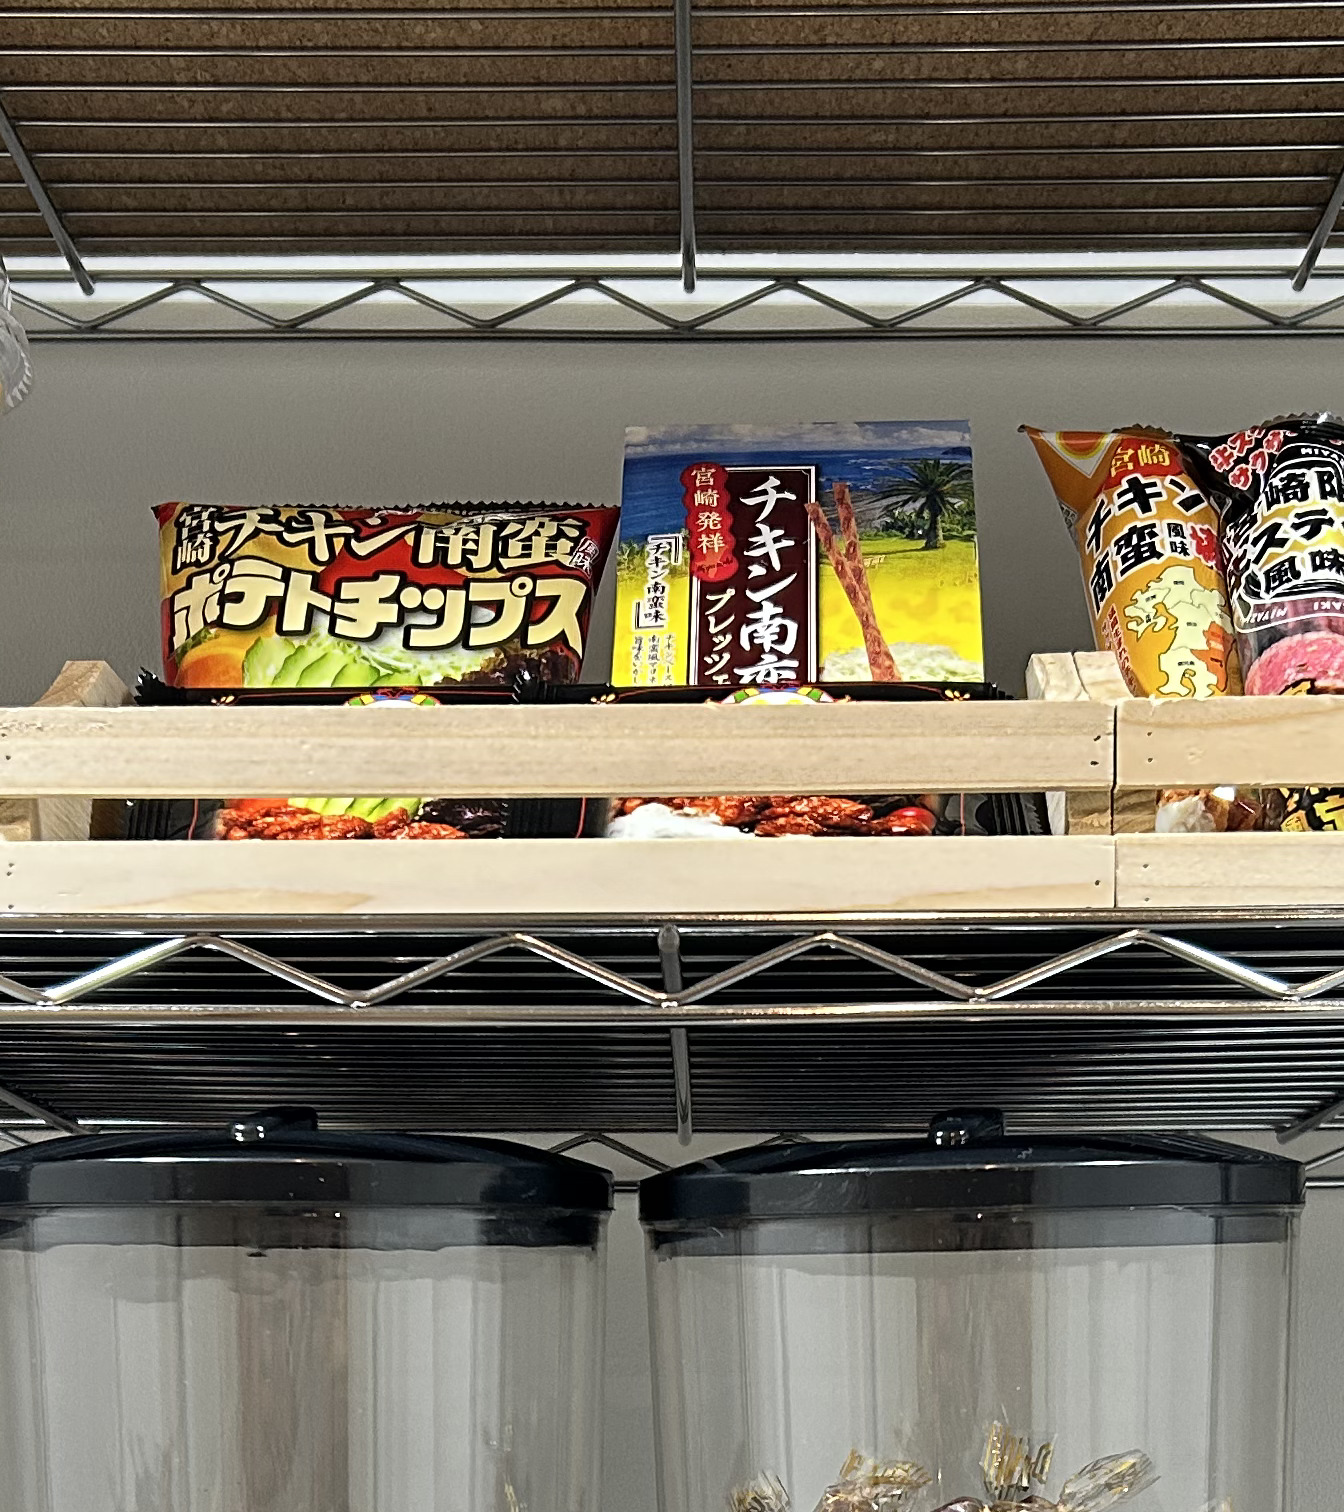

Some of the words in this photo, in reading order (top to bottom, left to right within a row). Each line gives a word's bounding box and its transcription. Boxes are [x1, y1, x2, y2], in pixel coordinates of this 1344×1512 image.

[1111, 443, 1170, 478] 宮崎
[171, 506, 214, 570] 宮崎
[214, 508, 586, 571] チキン南蛮
[691, 468, 726, 554] 宮崎発祥
[1087, 476, 1205, 553] チキン
[1167, 522, 1190, 556] 風味
[173, 558, 586, 660] ポテトチップス
